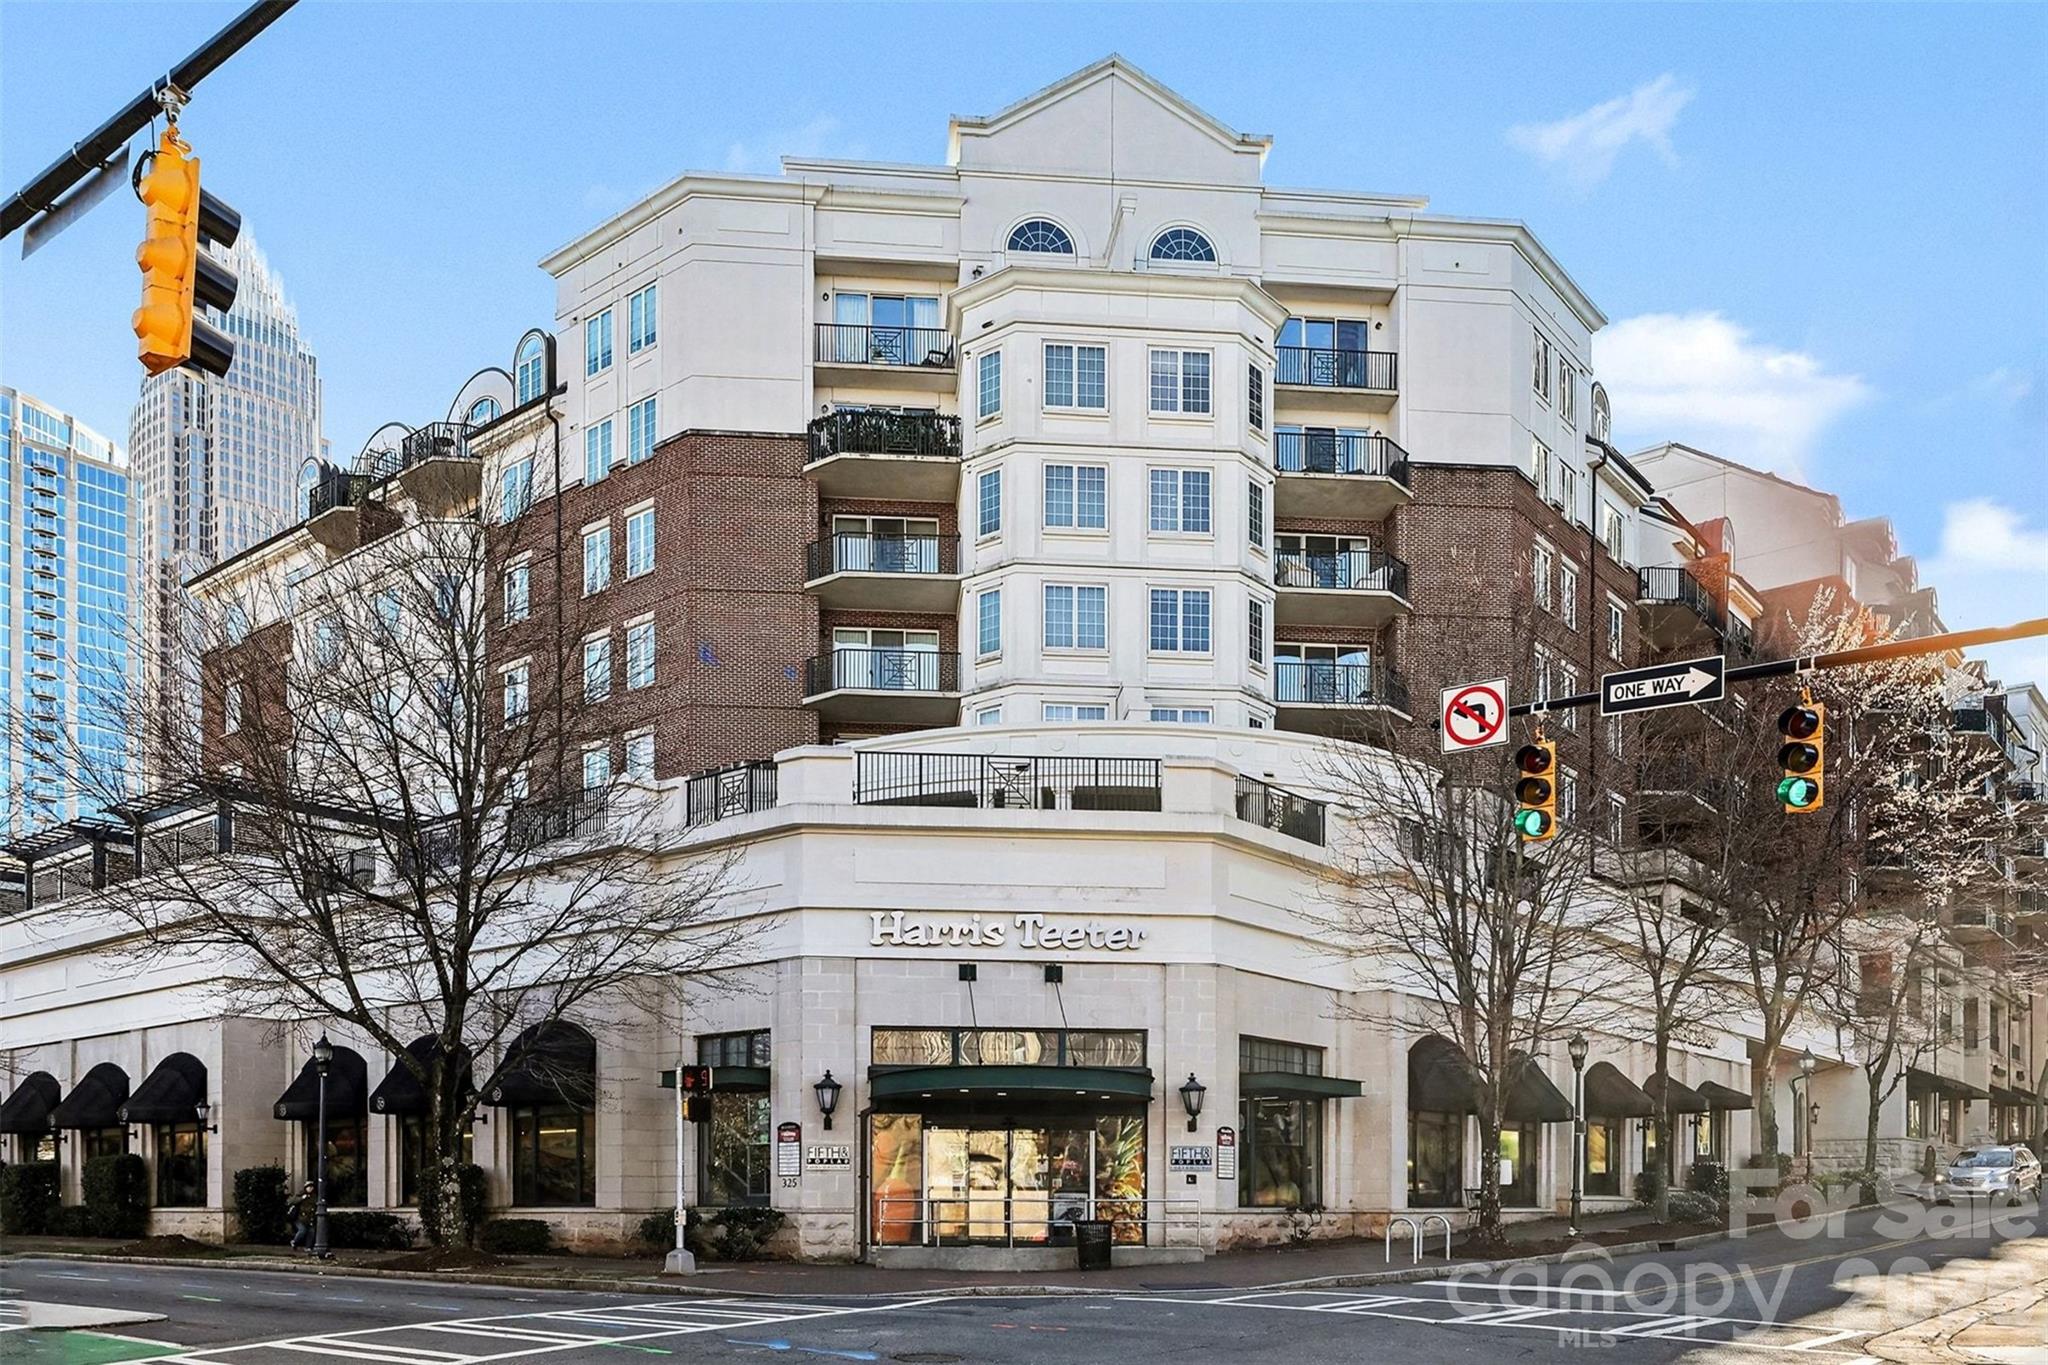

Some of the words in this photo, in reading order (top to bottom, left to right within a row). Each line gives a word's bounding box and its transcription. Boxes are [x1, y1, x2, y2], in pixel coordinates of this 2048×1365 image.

[1614, 682, 1645, 700] ONE
[1652, 676, 1685, 694] WAY
[869, 910, 1006, 946] Harris
[1014, 913, 1147, 950] Teeter
[701, 1069, 708, 1086] 9
[782, 1178, 797, 1188] 325
